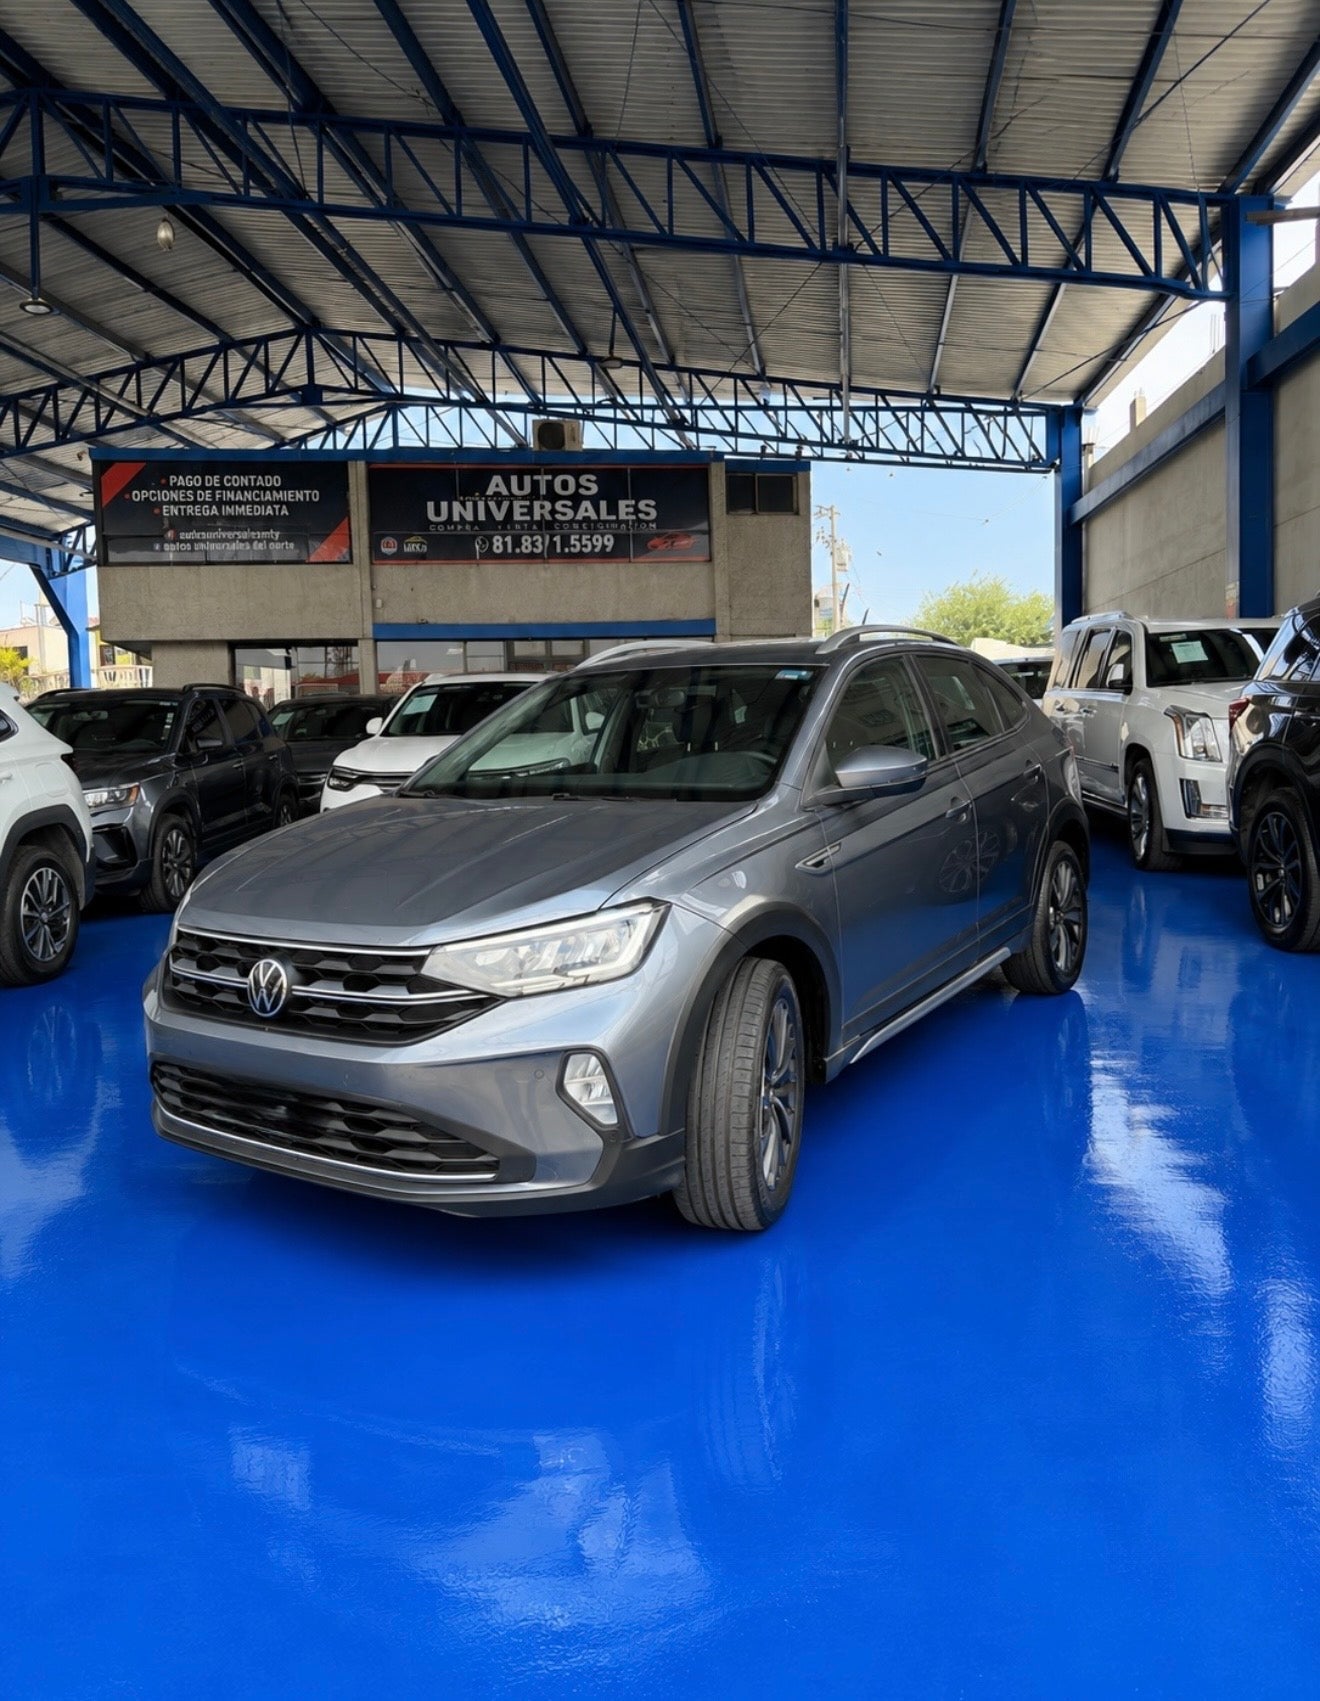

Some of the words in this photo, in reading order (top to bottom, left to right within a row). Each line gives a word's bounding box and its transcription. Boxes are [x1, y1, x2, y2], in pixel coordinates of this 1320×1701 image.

[169, 475, 202, 487] PAGO
[205, 475, 221, 487] DE
[223, 475, 282, 487] CONTADO
[485, 474, 599, 496] AUTOS
[132, 490, 194, 501] OPCIONES
[197, 490, 213, 501] DE
[215, 490, 320, 502] FINANCIAMIENTO
[162, 504, 219, 516] ENTREGA
[222, 504, 290, 516] INMEDIATA
[426, 499, 658, 522] UNIVERSALES
